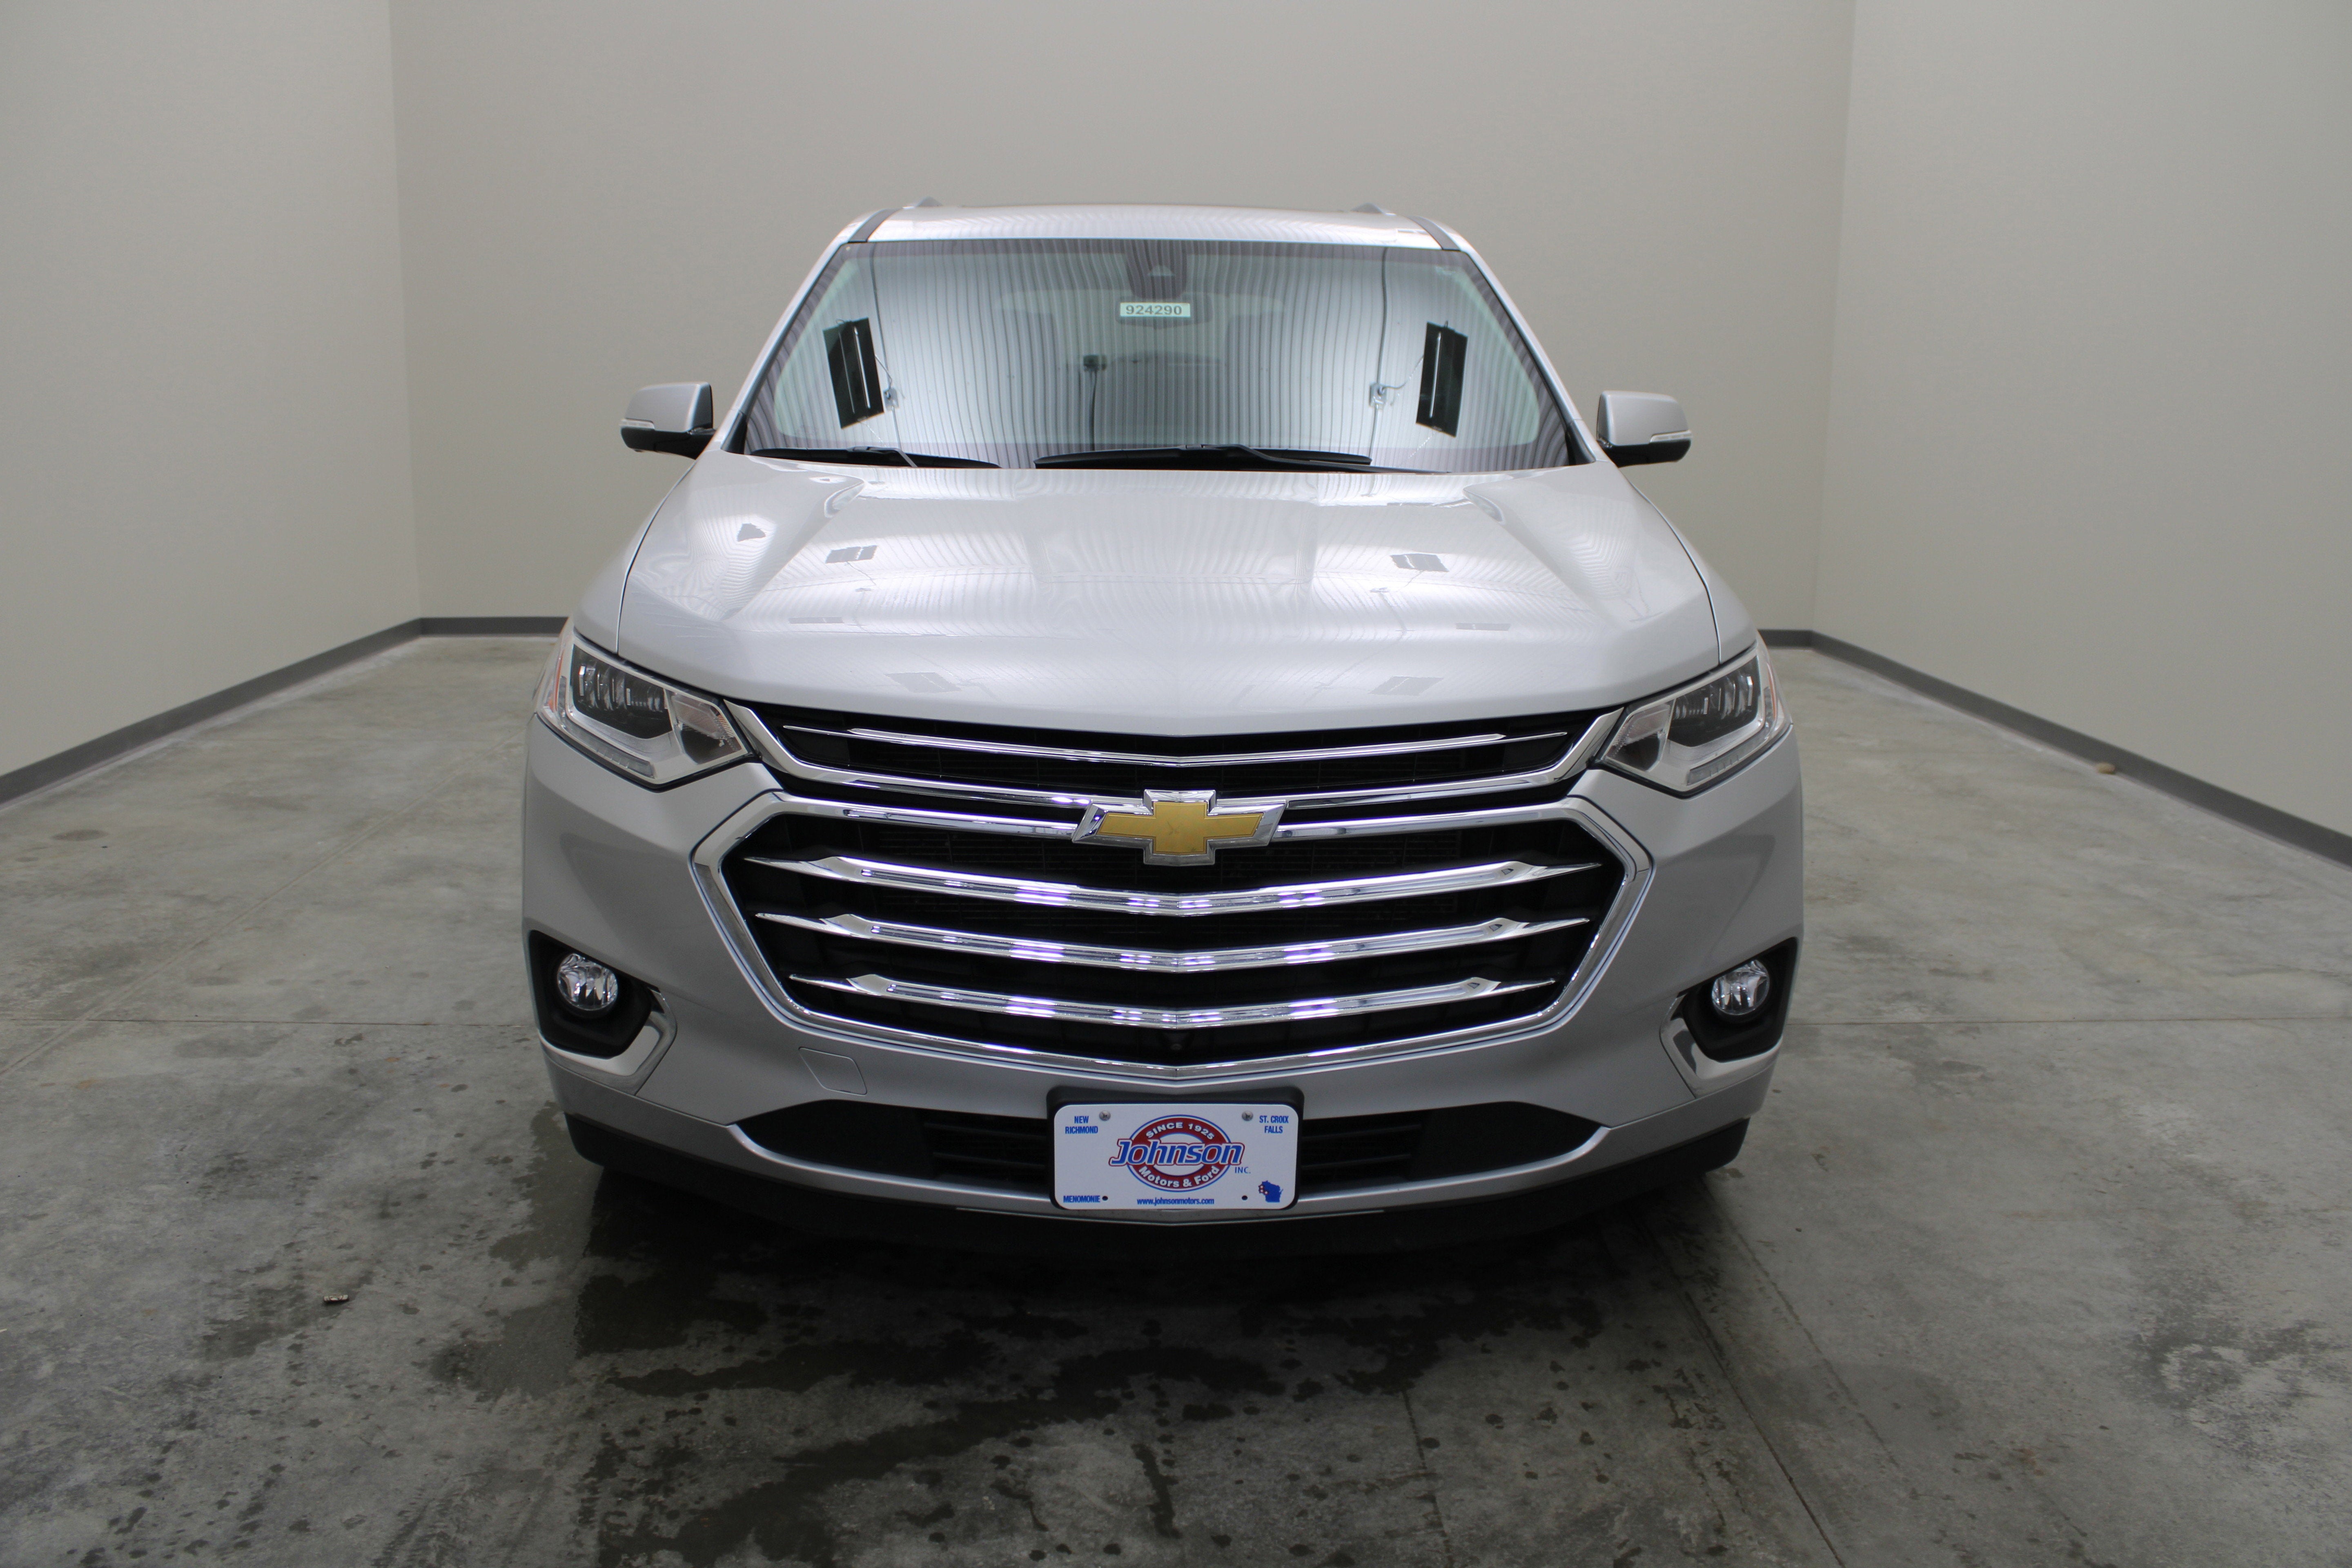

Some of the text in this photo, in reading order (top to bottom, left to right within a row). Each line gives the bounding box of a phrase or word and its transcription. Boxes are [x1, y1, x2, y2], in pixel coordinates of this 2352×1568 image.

[1126, 304, 1182, 315] 924290
[1146, 1123, 1214, 1140] SINCE 1925
[1111, 1140, 1243, 1165] Johnson
[1138, 1166, 1220, 1188] Motors & Ford
[1137, 1197, 1214, 1206] www.johnsonmotors.com
